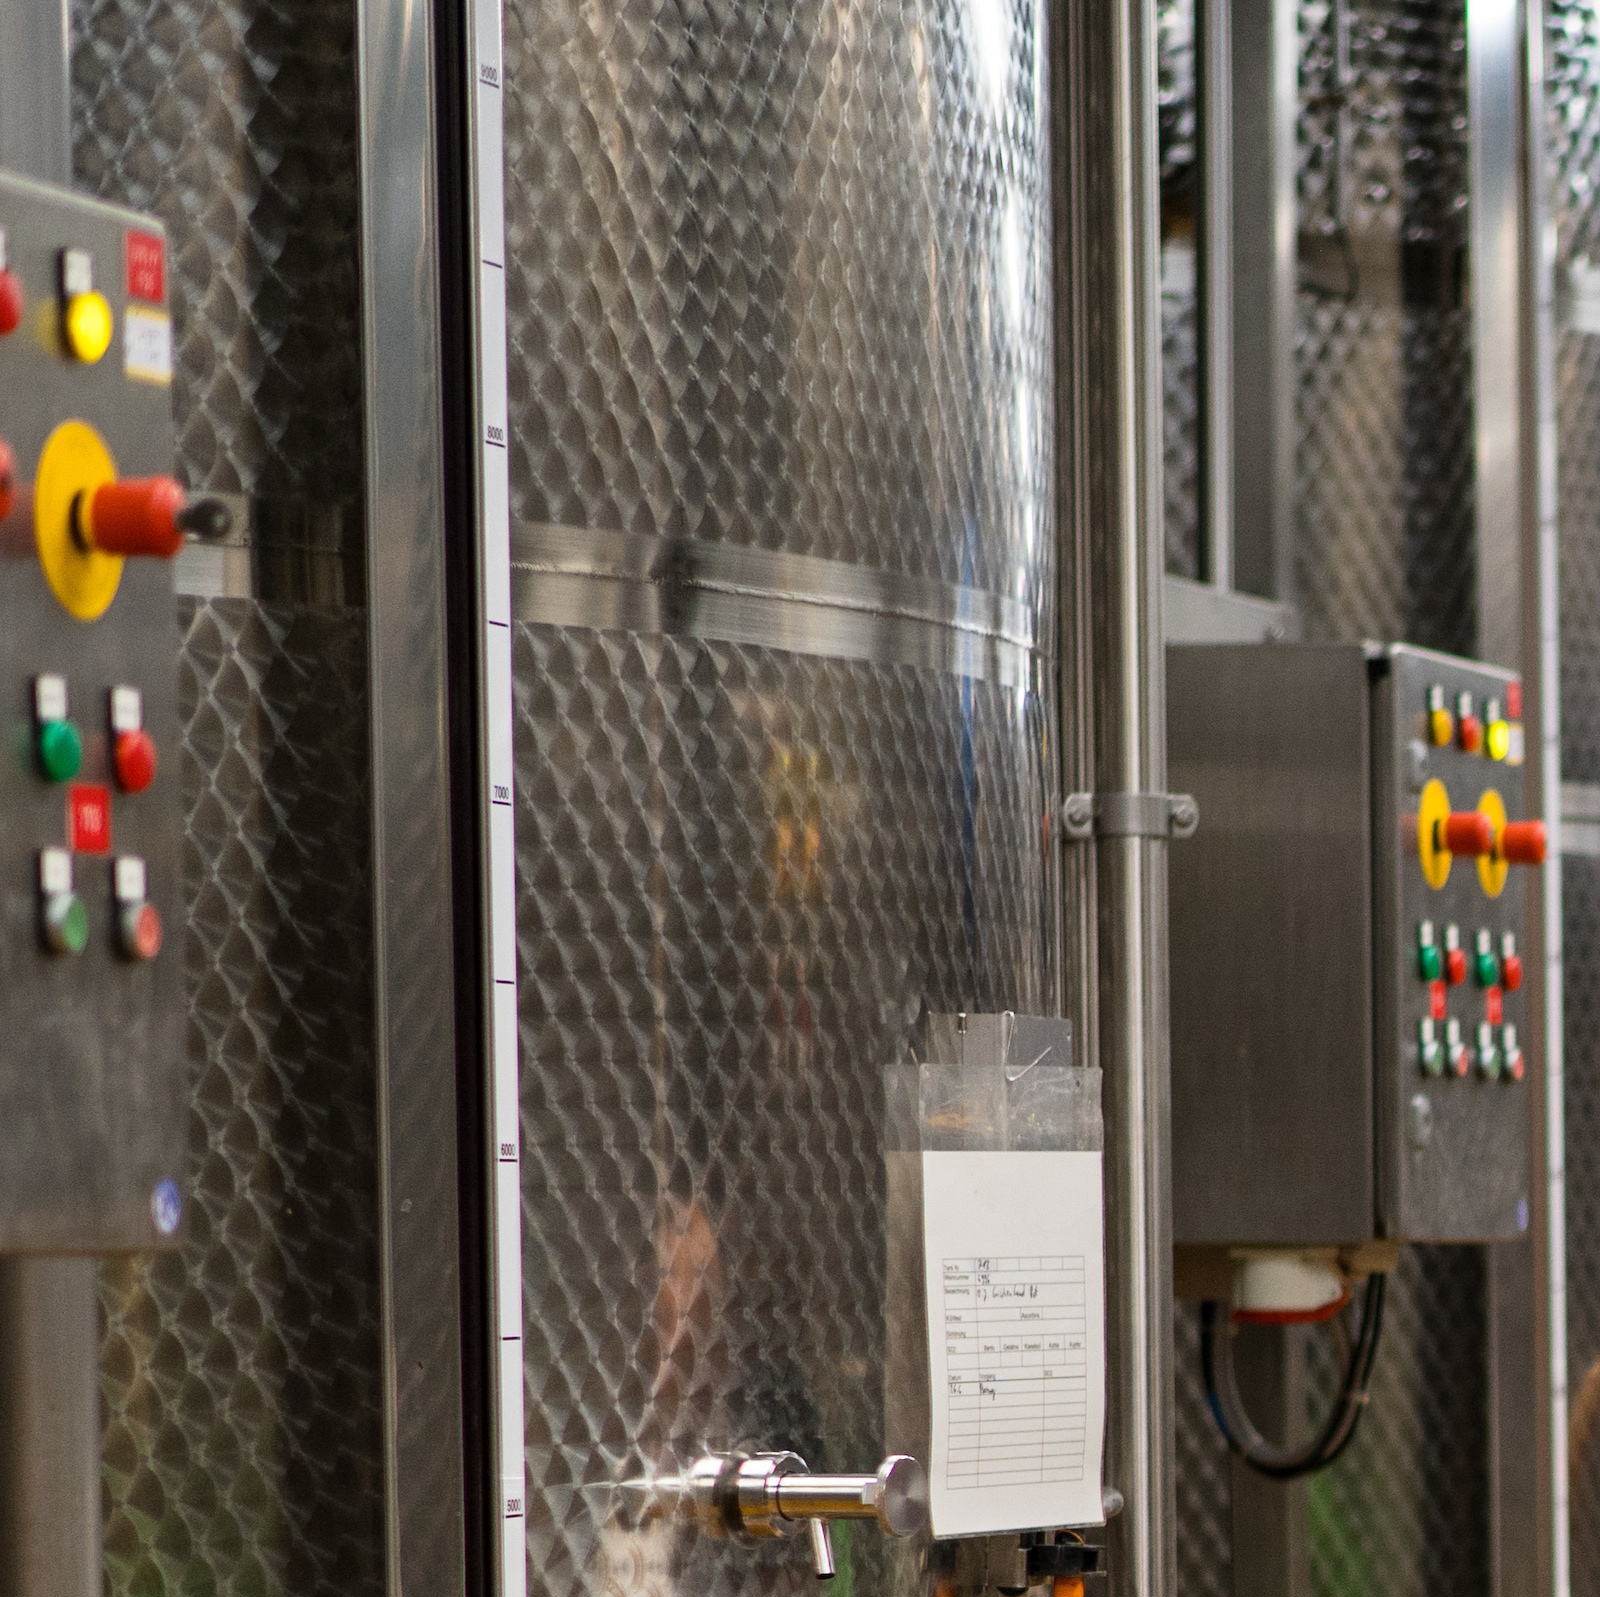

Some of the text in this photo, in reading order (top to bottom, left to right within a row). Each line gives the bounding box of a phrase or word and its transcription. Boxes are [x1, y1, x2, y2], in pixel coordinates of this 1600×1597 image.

[487, 425, 504, 442] 8000
[494, 784, 510, 800] 7000
[501, 1143, 515, 1156] 6000
[507, 1499, 521, 1512] 5000
